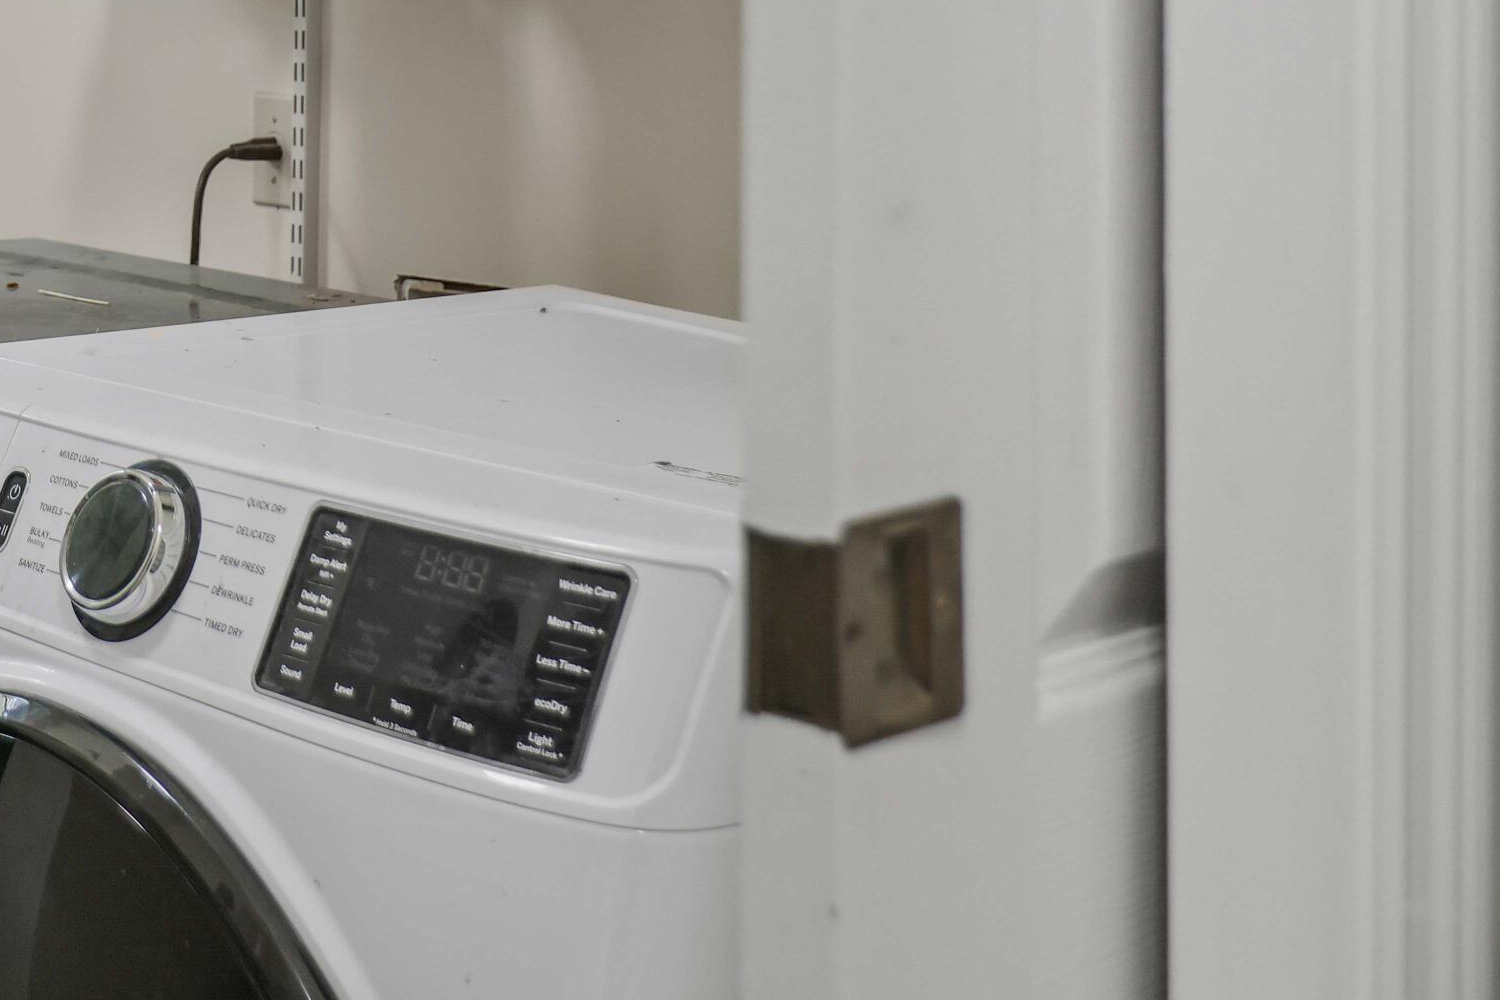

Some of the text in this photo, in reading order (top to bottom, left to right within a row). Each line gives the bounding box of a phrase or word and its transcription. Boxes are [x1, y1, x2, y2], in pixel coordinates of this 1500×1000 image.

[59, 449, 100, 466] MIXED LOADS
[49, 474, 79, 490] COTTONS
[40, 502, 64, 516] TOWELS
[246, 497, 287, 515] QUICK DRY
[30, 527, 49, 540] BULKY
[236, 525, 276, 544] DELICATES
[323, 530, 352, 547] Settings
[18, 558, 46, 574] SANITIZE
[219, 554, 266, 576] PERM PRESS
[330, 558, 348, 571] Alert
[211, 585, 255, 606] DEWRINKLE
[559, 578, 617, 600] Wrinkle Care
[301, 588, 333, 608] Delay Dry
[204, 617, 244, 639] TIMED DRY
[547, 614, 572, 629] More
[572, 620, 596, 635] Time
[293, 627, 313, 641] Small
[290, 640, 308, 653] Load
[280, 664, 302, 679] Sound
[536, 654, 557, 668] Less
[559, 658, 582, 674] Time
[334, 682, 354, 696] Level
[390, 698, 412, 715] Temp
[534, 698, 568, 714] ecoDry
[394, 723, 418, 737] Seconds
[452, 715, 474, 731] Time
[528, 731, 553, 747] Light
[516, 741, 558, 760] Control Lock
